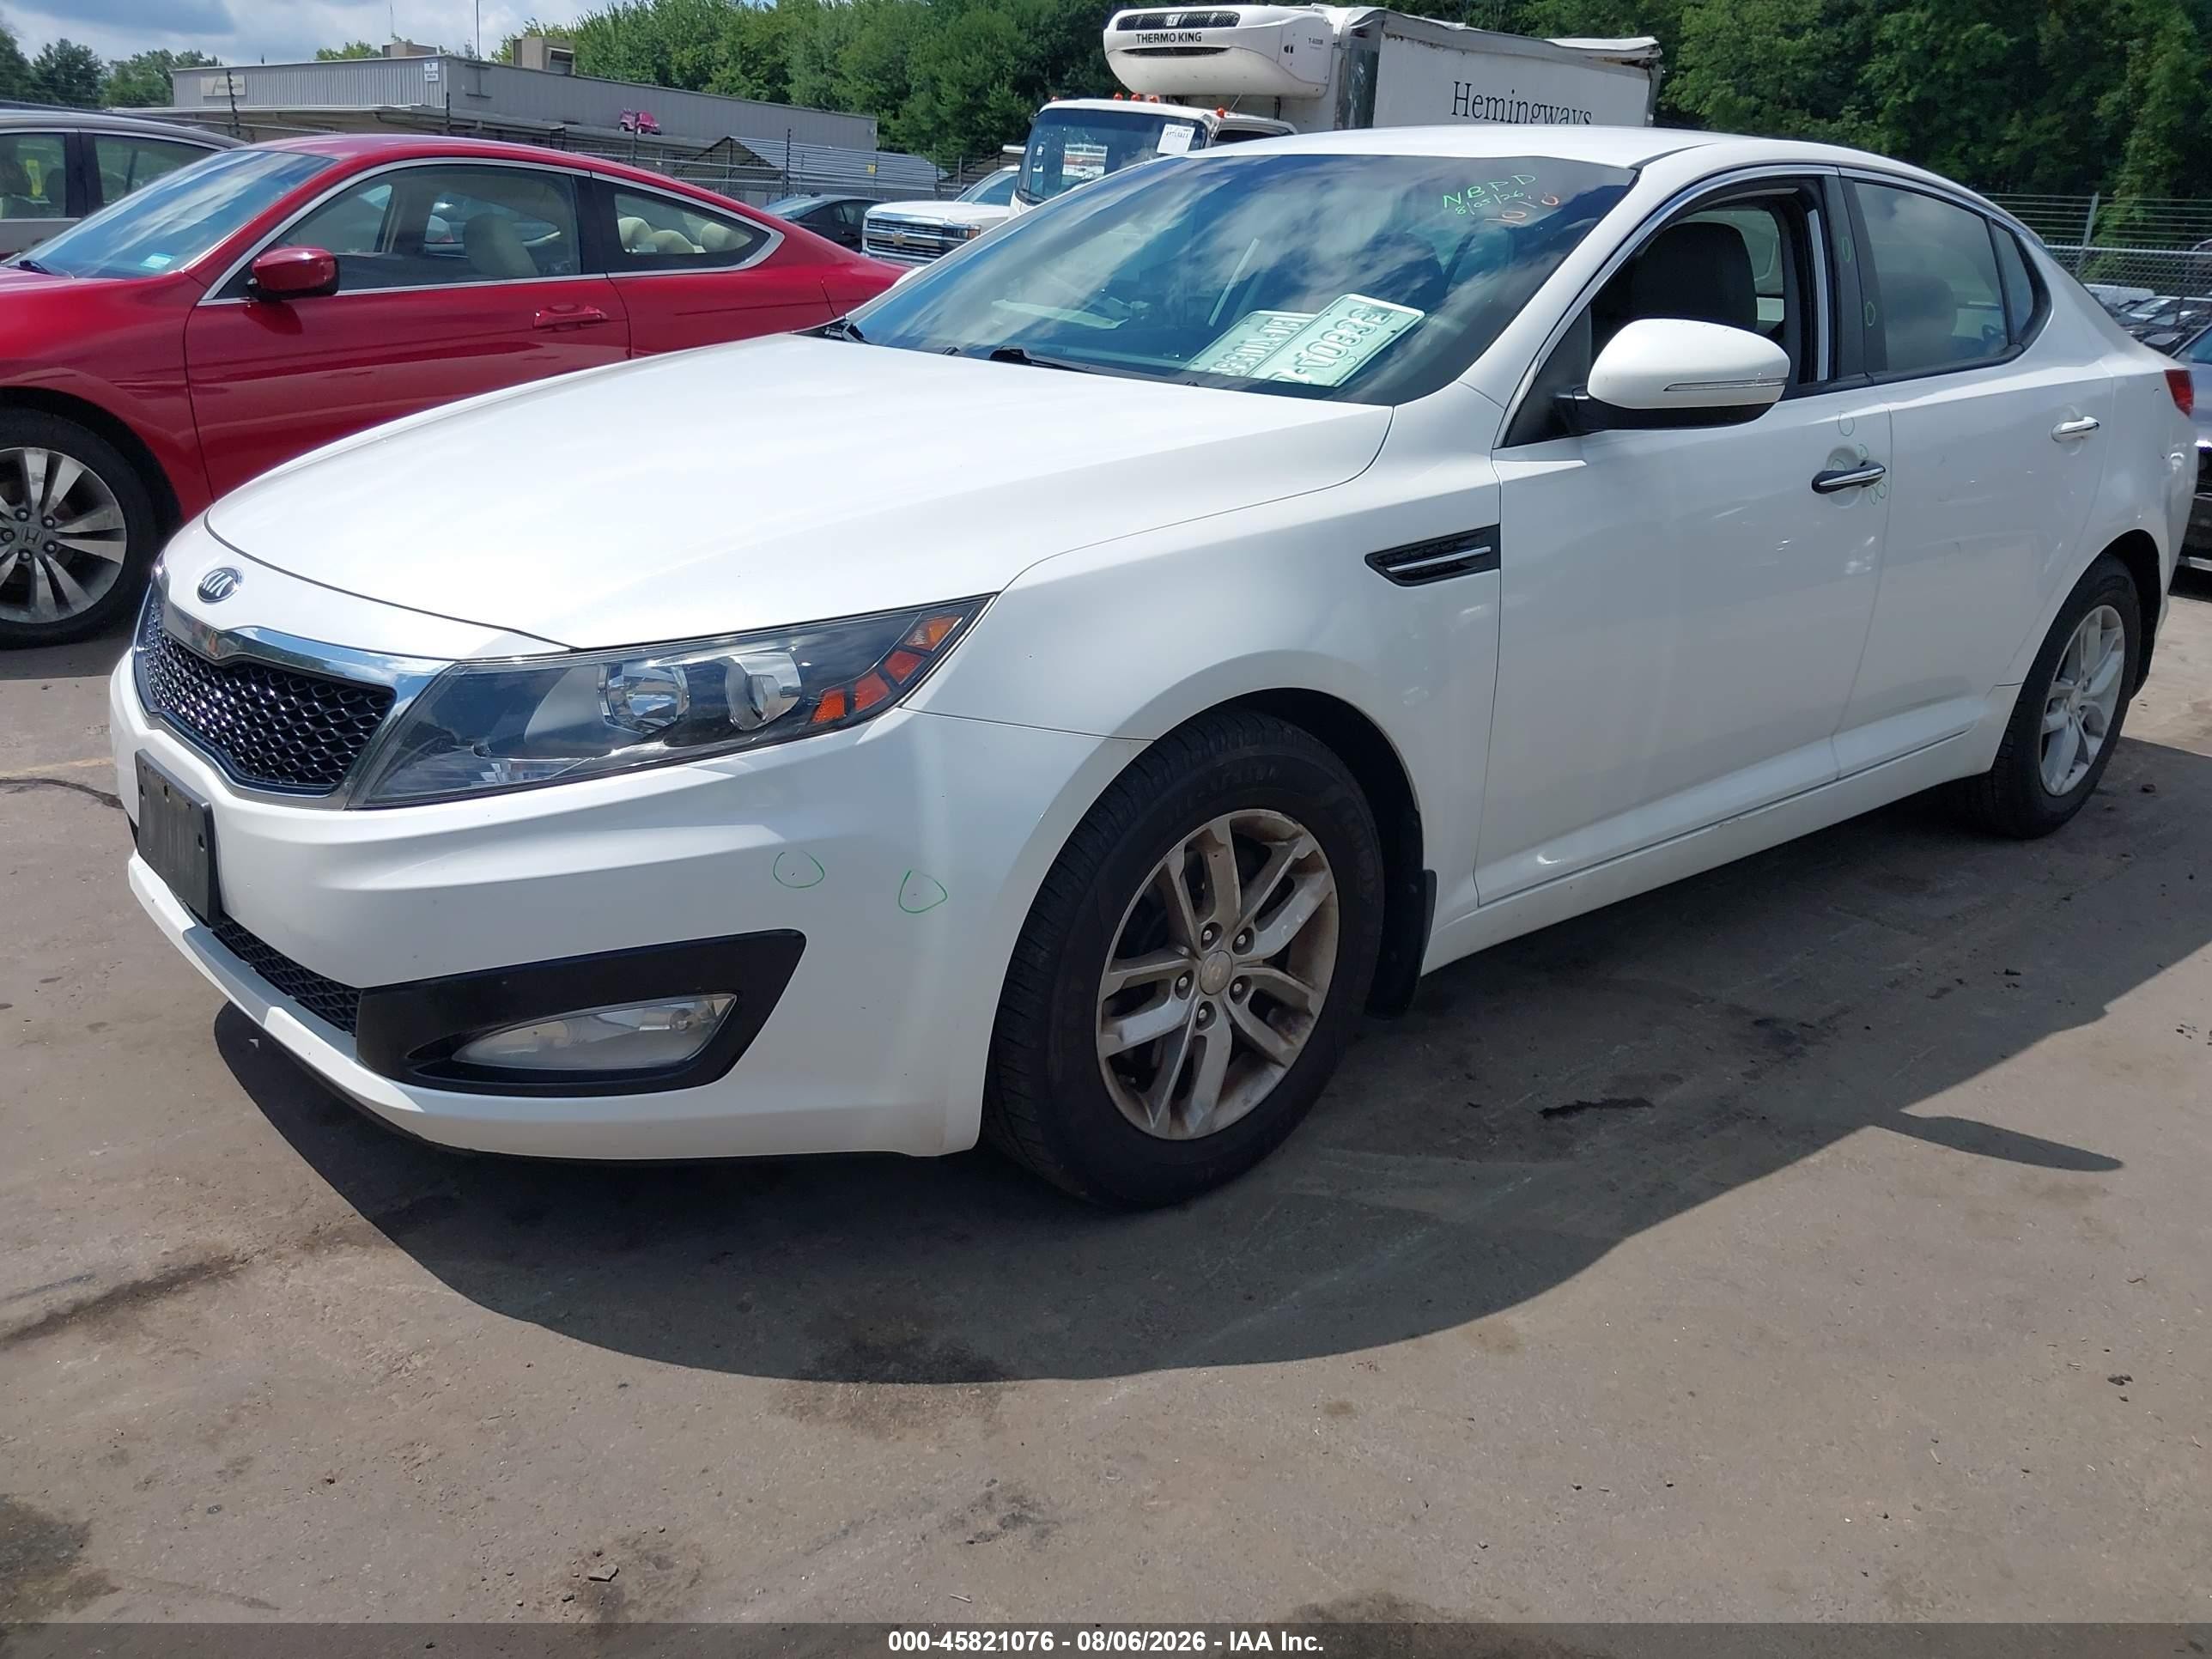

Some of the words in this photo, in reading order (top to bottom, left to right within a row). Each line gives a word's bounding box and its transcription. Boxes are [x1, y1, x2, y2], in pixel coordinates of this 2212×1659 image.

[1135, 33, 1176, 44] THERMO
[1178, 31, 1203, 43] KING
[1450, 81, 1593, 125] Hemingways
[201, 570, 234, 598] KIA
